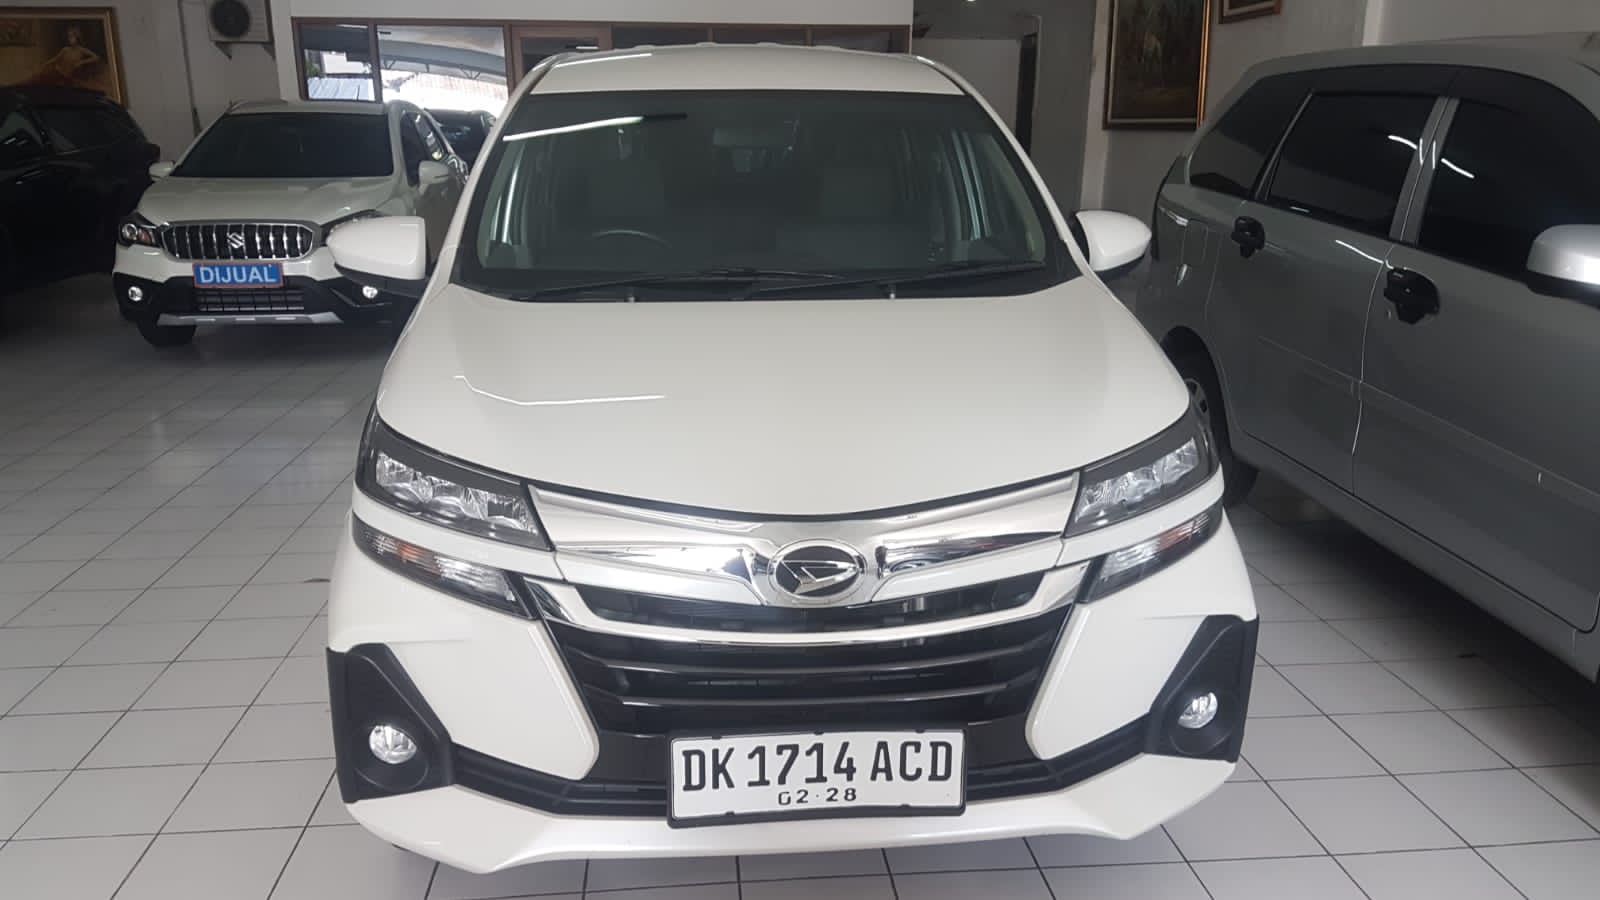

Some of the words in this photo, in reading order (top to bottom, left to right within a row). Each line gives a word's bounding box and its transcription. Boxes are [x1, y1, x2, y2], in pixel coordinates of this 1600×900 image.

[199, 266, 277, 283] DIJUAL
[681, 747, 735, 791] DK
[747, 741, 857, 787] 1714
[869, 740, 952, 782] ACD
